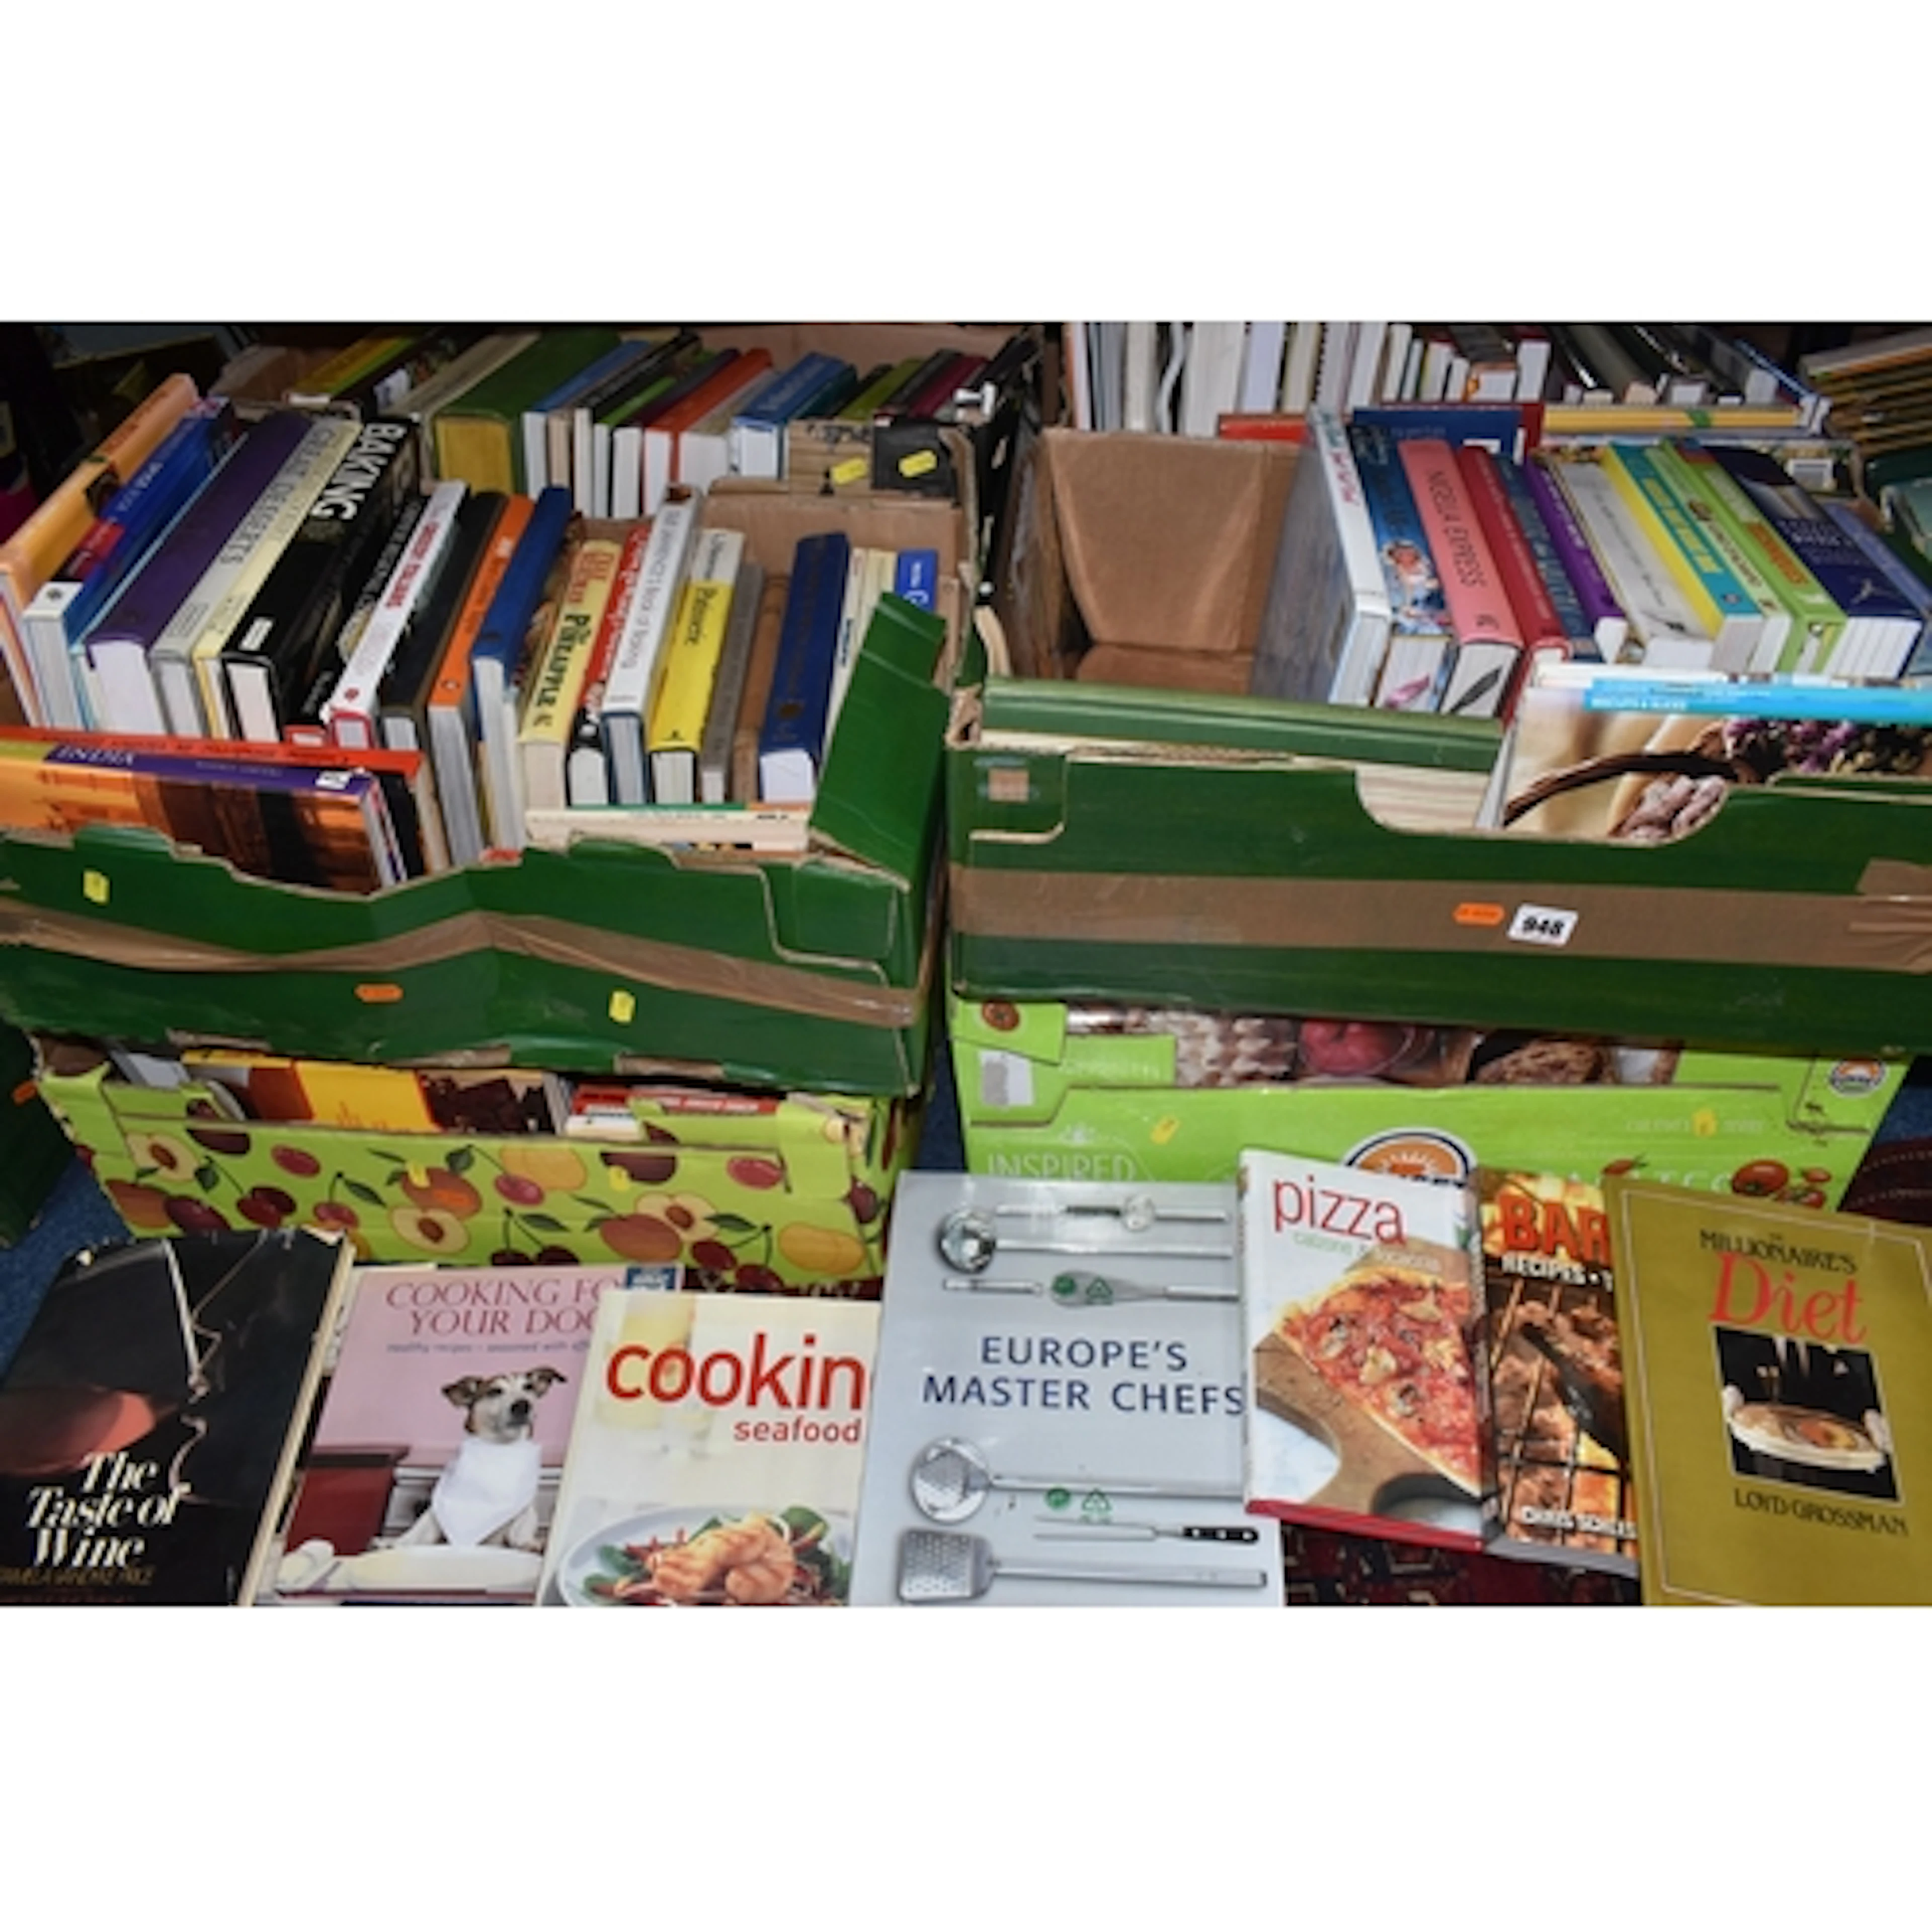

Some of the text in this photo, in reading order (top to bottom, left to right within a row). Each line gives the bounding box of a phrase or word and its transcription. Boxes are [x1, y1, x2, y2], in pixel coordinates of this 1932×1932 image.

[310, 422, 408, 521] BAKING
[1442, 525, 1487, 588] EXPRESS
[1522, 916, 1564, 938] 948
[1272, 1175, 1407, 1245] pizza
[1501, 1250, 1586, 1285] RECIPES
[386, 1279, 560, 1308] COOKING
[1706, 1250, 1868, 1345] Diet
[410, 1309, 510, 1336] YOUR
[605, 1331, 867, 1410] cookin
[981, 1335, 1187, 1372] EUROPE'S
[922, 1375, 1245, 1416] MASTER CHEFS
[733, 1416, 862, 1443] seafood
[80, 1451, 159, 1492] The
[28, 1483, 191, 1528] Taste of
[34, 1528, 146, 1568] Wine
